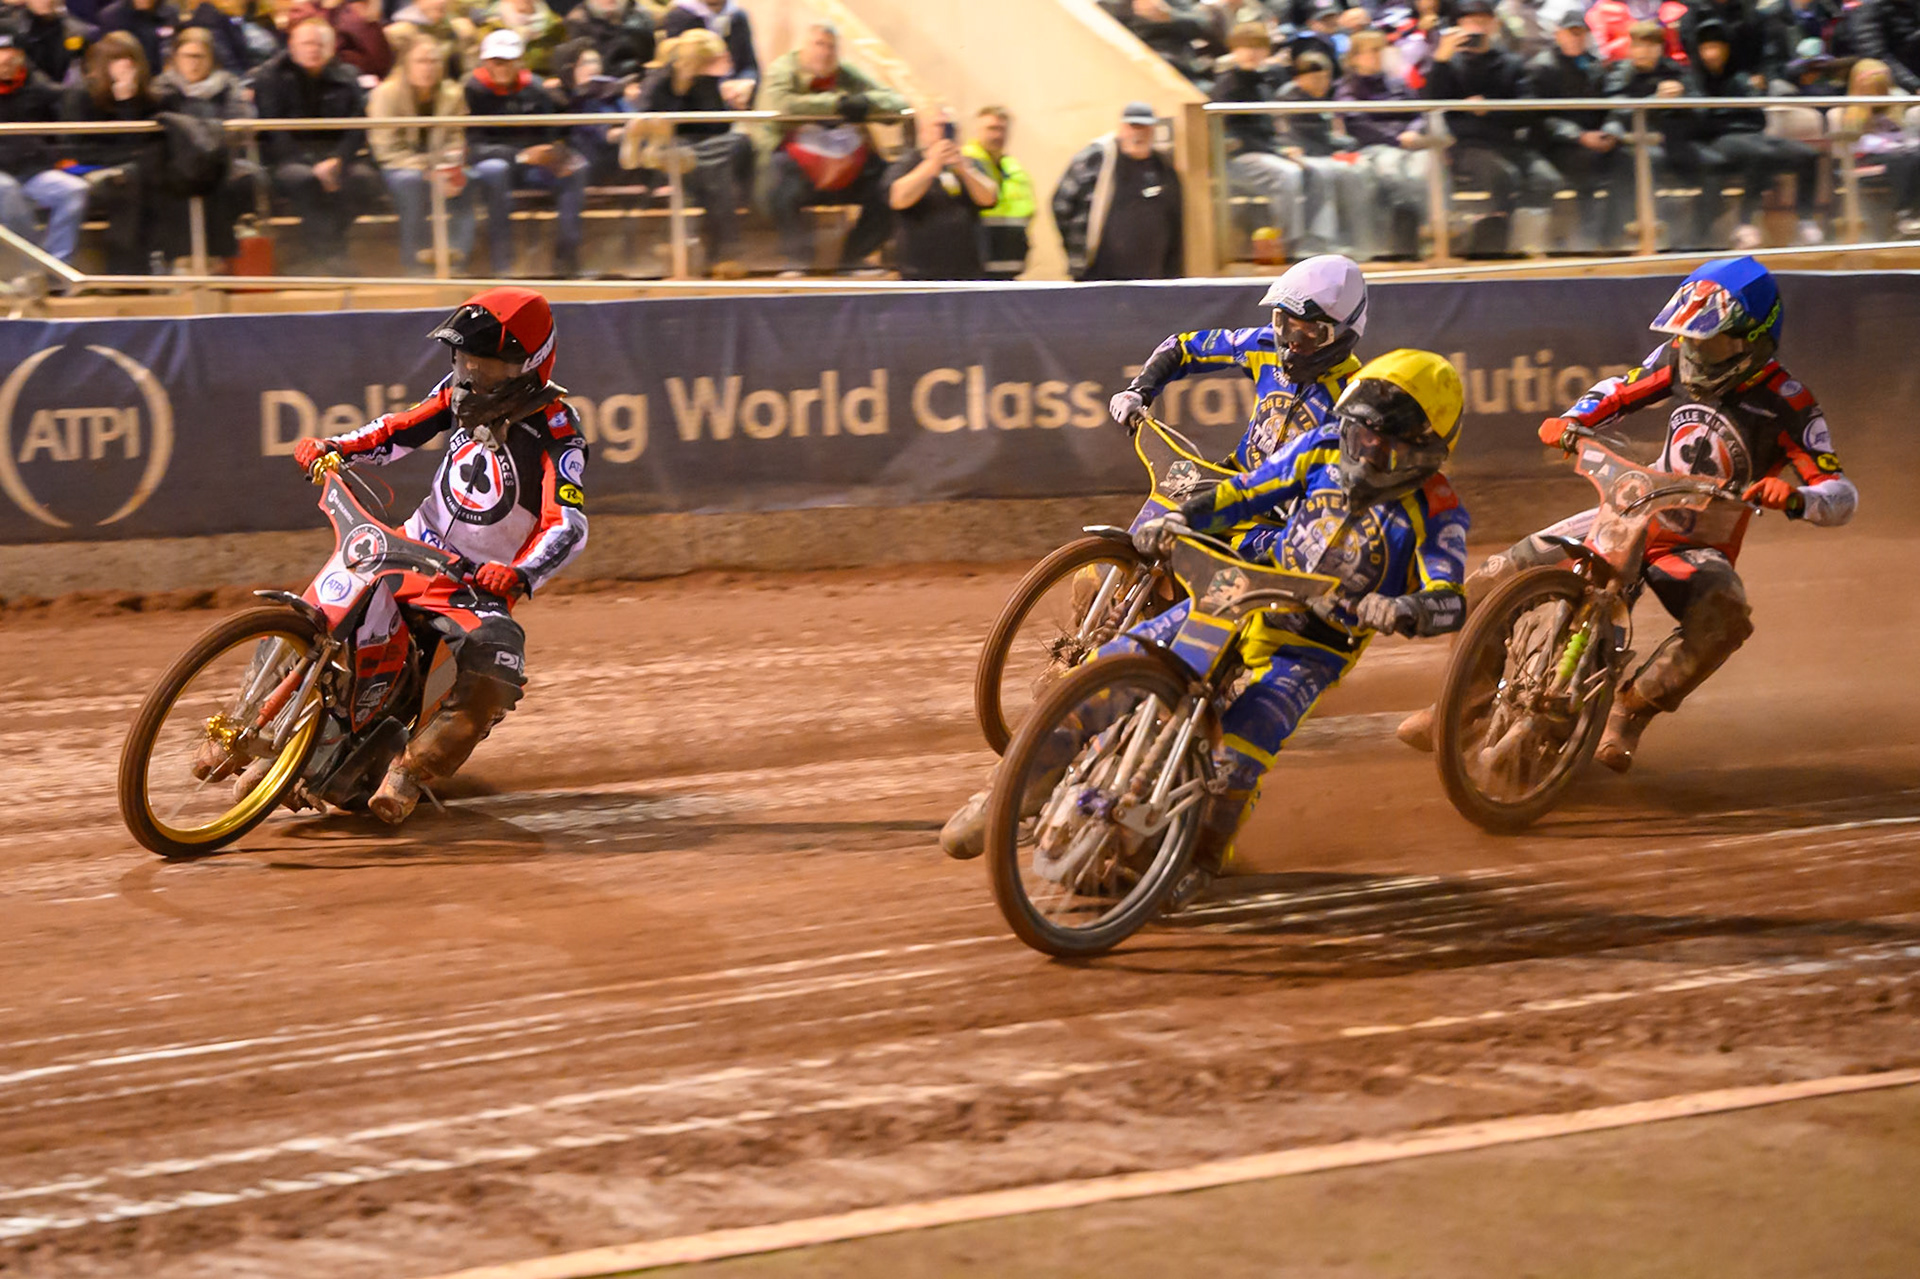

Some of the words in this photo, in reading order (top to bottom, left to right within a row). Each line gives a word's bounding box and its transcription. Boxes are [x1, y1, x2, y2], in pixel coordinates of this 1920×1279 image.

[17, 406, 141, 464] ATPI
[664, 369, 889, 441] World
[911, 365, 1106, 433] Class
